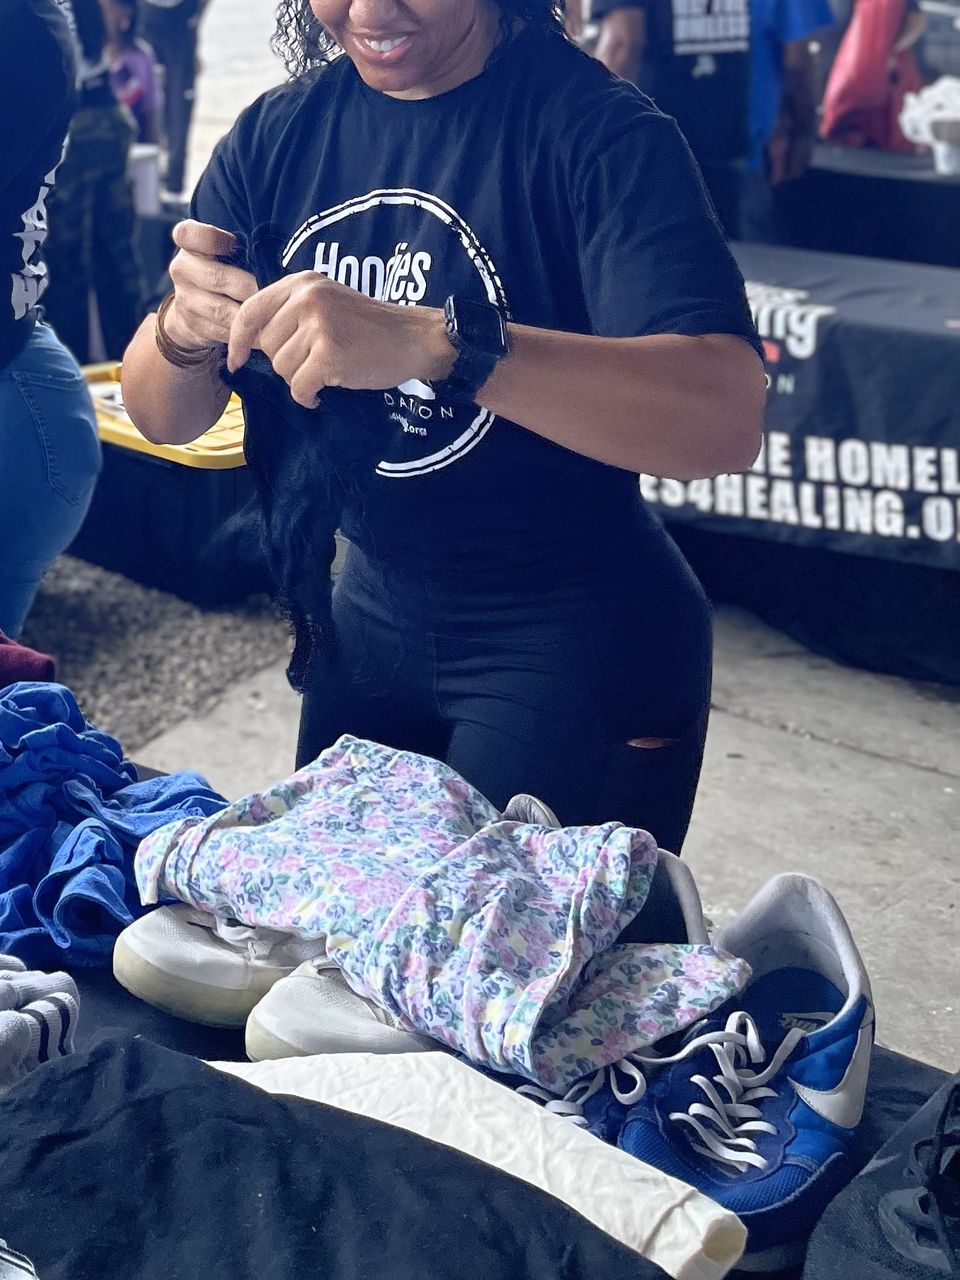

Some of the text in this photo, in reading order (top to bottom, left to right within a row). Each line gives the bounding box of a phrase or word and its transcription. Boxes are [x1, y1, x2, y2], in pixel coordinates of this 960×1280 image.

[384, 392, 454, 419] DATION
[804, 436, 960, 494] HOMEL
[640, 473, 960, 542] S4HEALING.O
